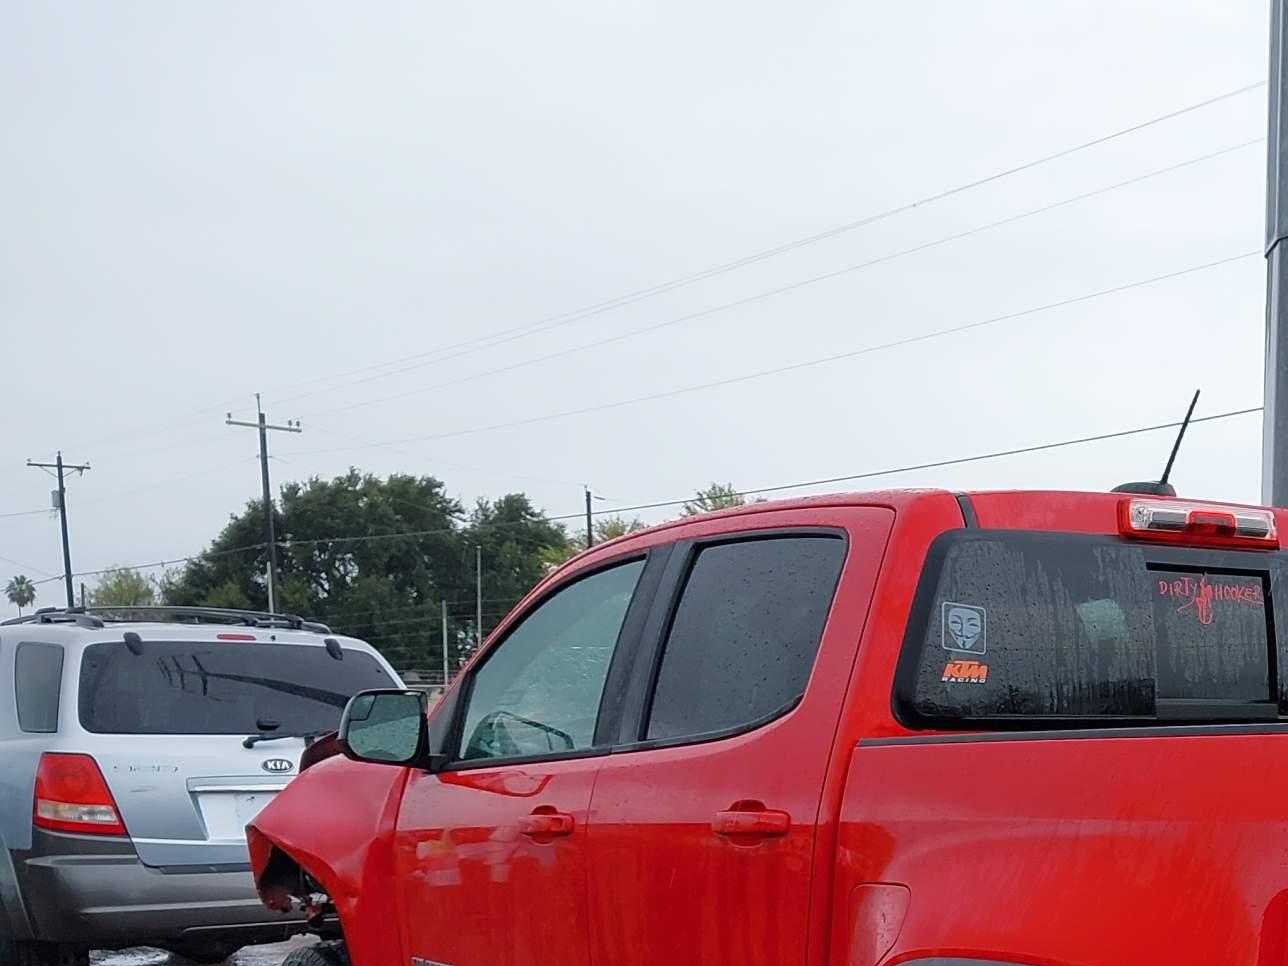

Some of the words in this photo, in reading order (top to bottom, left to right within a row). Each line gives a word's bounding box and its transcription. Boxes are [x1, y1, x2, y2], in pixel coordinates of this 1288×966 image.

[1159, 577, 1197, 605] DIRTY
[1215, 584, 1264, 605] HOOKER
[943, 660, 988, 678] KTM
[266, 760, 291, 770] KIA
